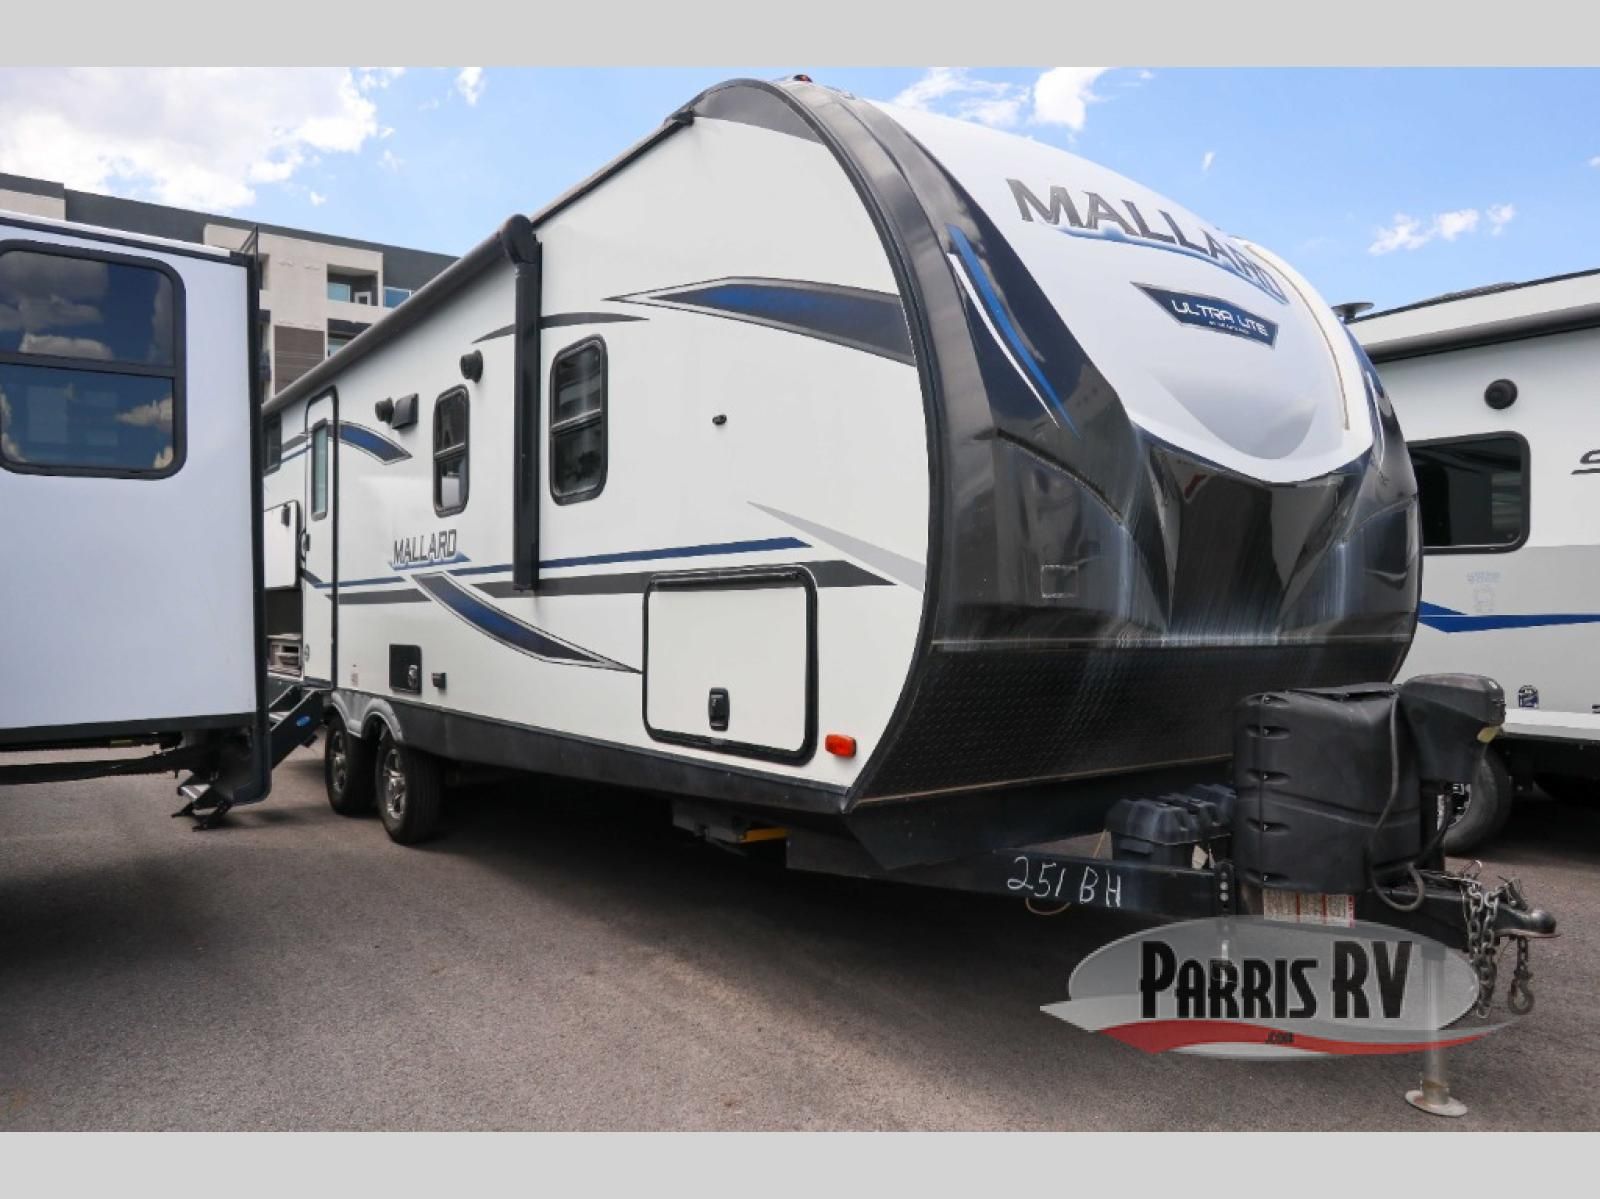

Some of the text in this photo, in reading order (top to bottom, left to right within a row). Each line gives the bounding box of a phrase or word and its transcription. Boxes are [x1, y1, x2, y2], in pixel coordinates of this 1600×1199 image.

[1006, 178, 1290, 304] MALLARD
[1171, 299, 1235, 323] ULTRA
[1236, 315, 1269, 337] LITE
[393, 529, 457, 564] MALLARD
[1007, 856, 1066, 897] 251
